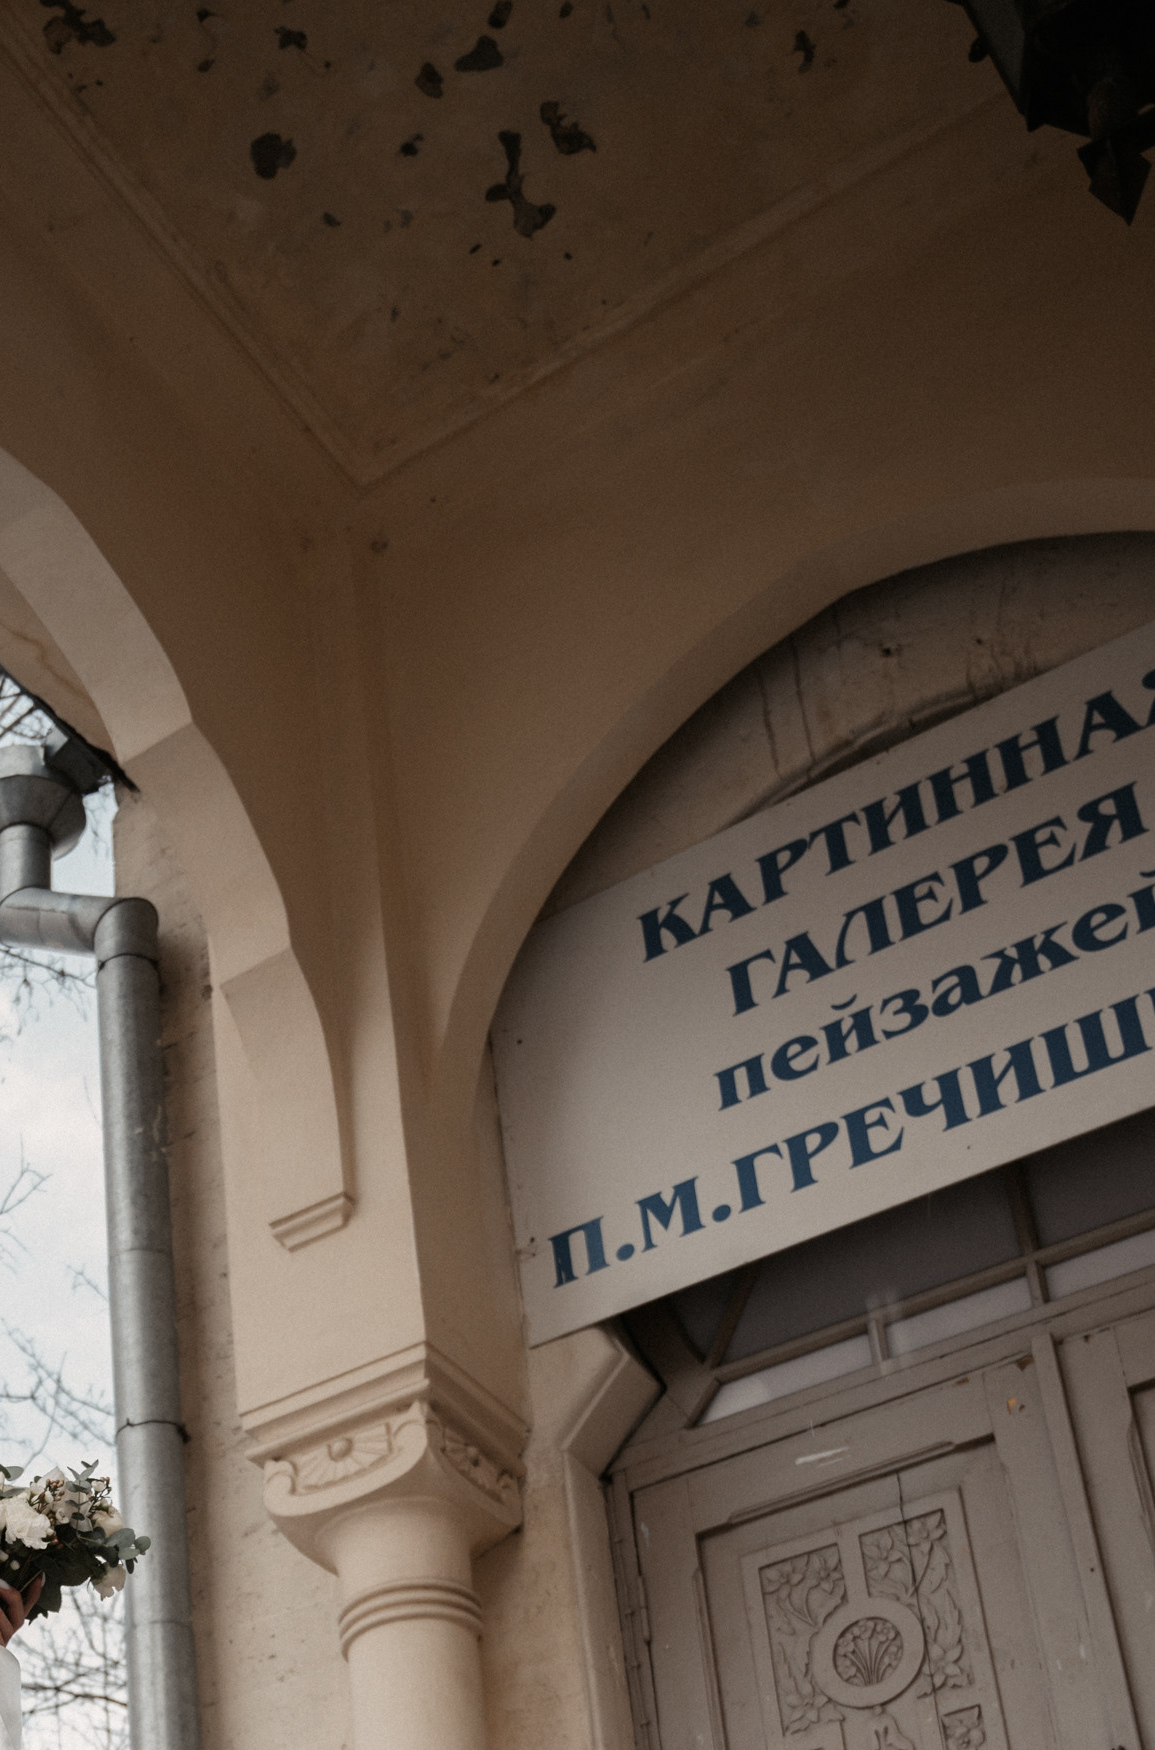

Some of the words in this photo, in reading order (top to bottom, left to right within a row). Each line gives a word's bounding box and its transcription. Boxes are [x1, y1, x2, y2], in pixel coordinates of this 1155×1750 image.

[635, 668, 1155, 962] КАРТИННА
[724, 781, 1149, 1016] ГАЛЕРЕЯ
[547, 985, 1155, 1288] П.М.ГРЕЧИШ
